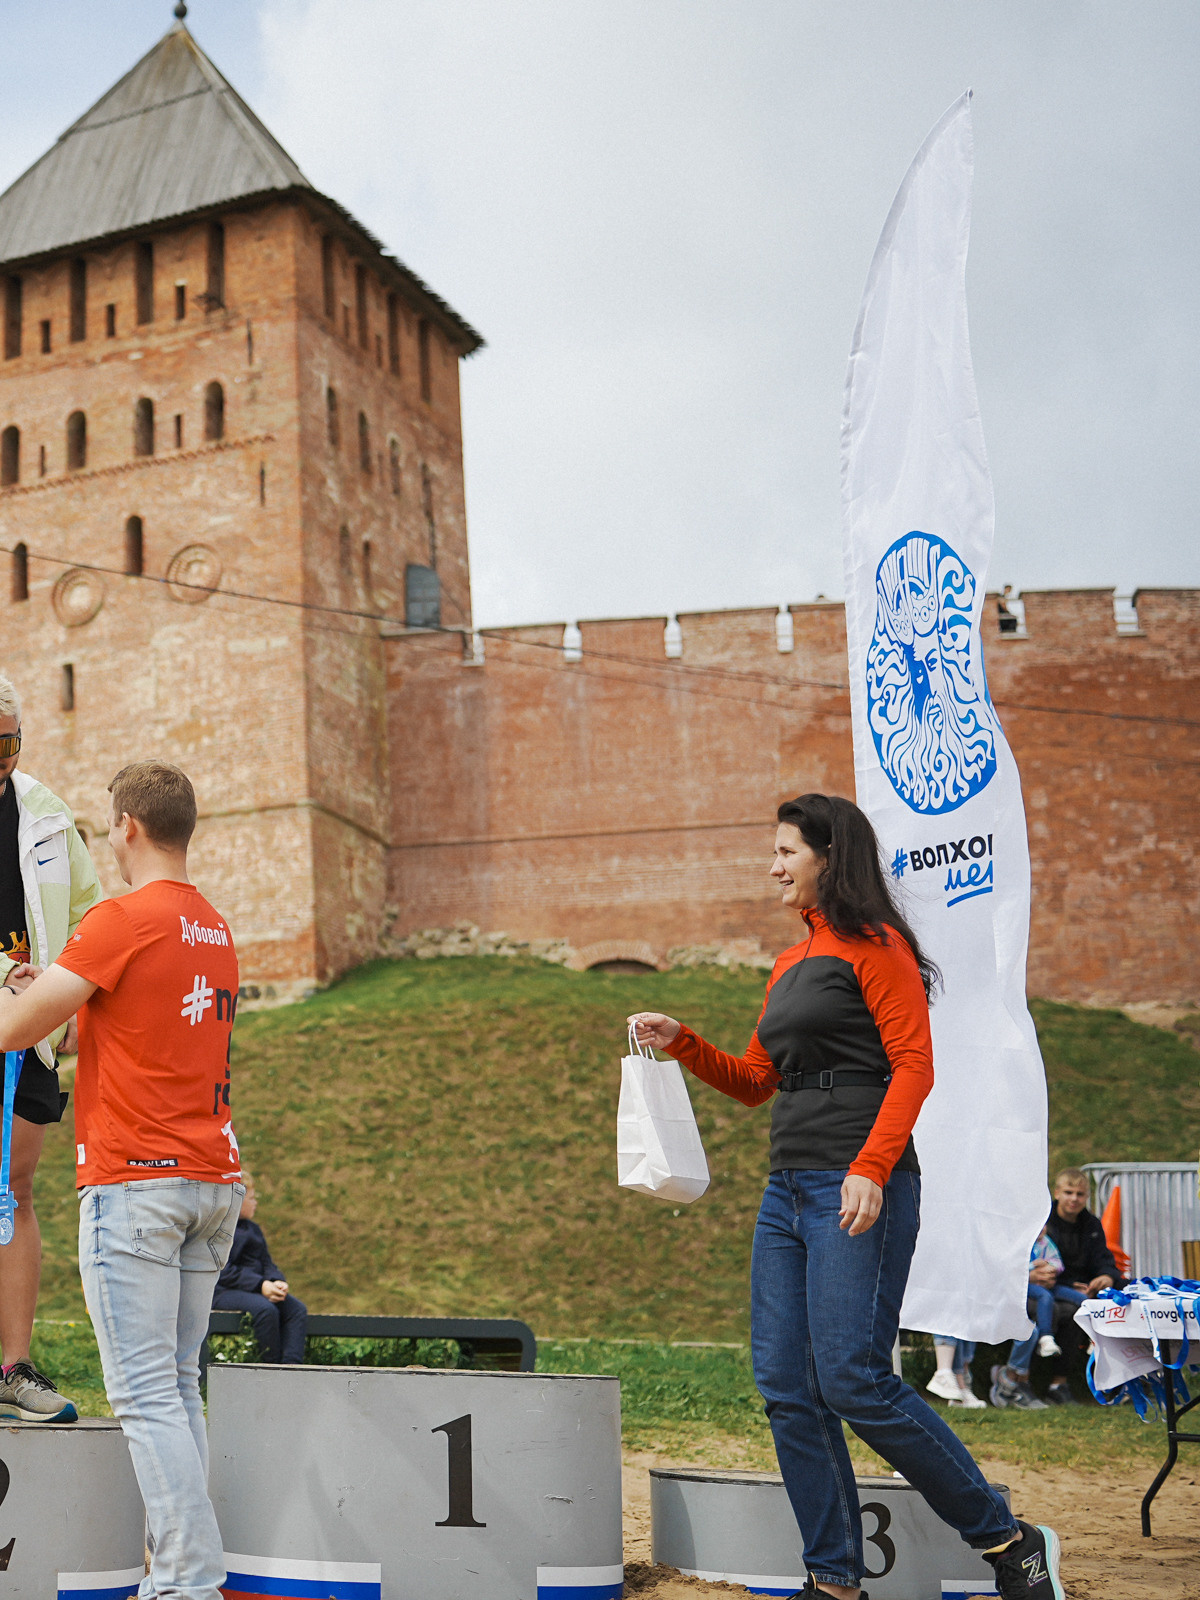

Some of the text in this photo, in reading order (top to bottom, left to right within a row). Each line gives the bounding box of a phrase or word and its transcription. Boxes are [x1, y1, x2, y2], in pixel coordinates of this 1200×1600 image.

[180, 915, 229, 947] Дубовой
[1106, 1306, 1127, 1319] TRI
[431, 1413, 487, 1528] 1
[859, 1502, 896, 1579] 3
